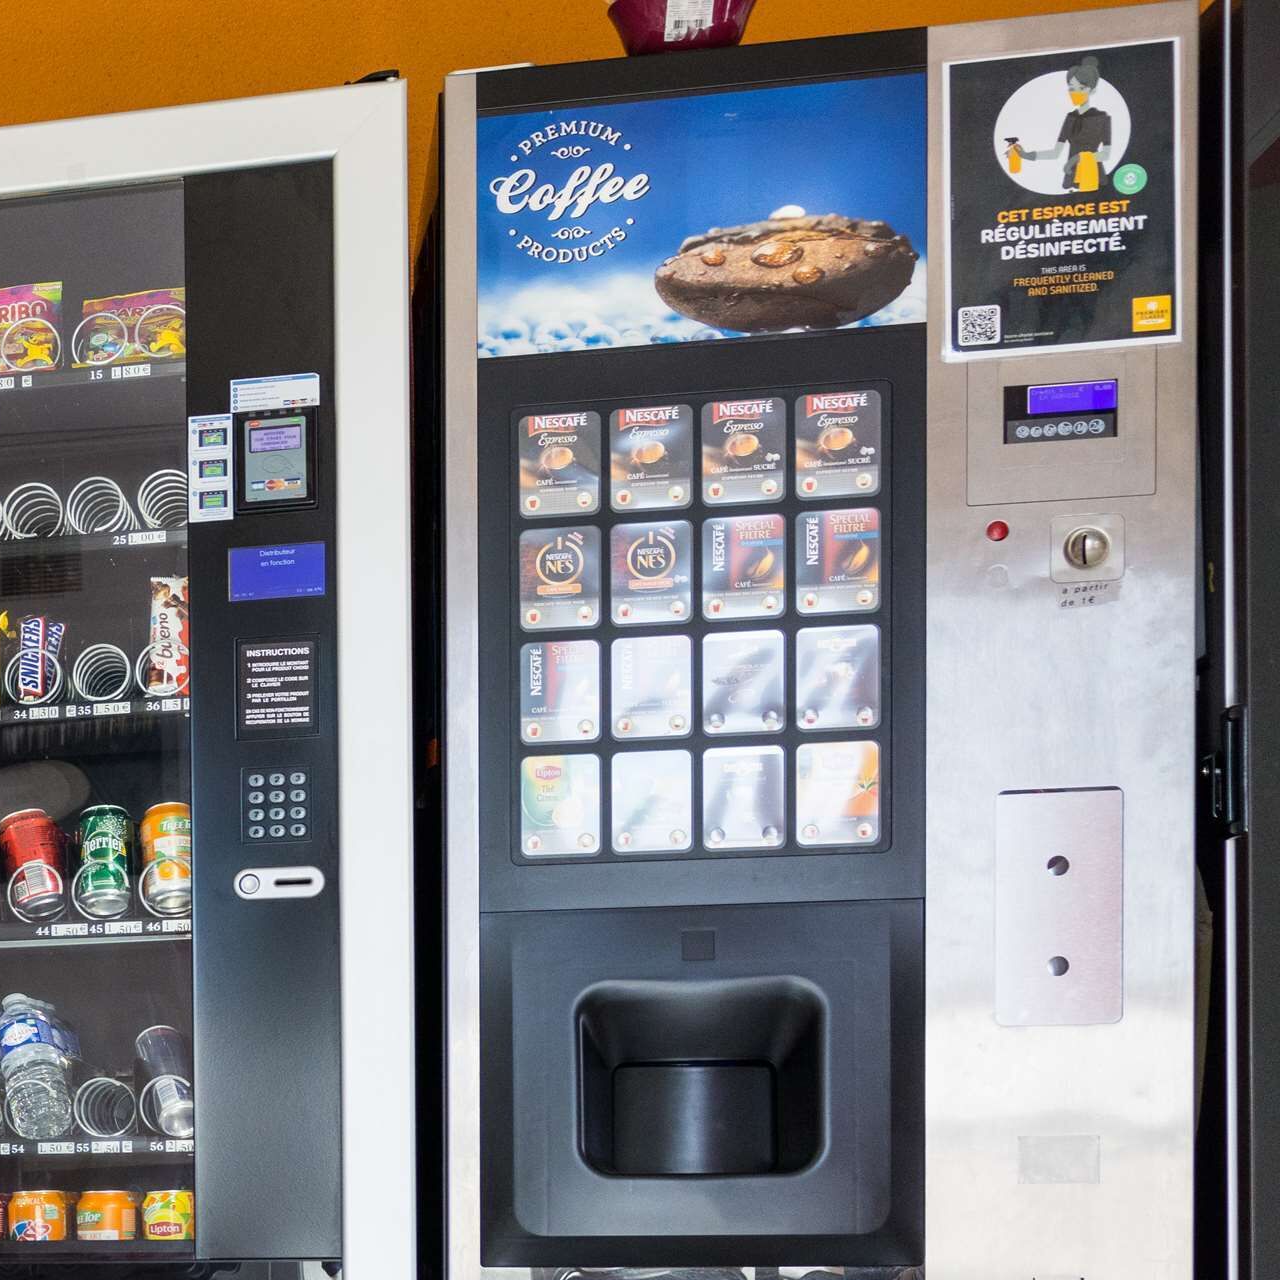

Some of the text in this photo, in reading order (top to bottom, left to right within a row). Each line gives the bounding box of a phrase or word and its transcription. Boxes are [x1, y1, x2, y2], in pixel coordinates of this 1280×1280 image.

[518, 120, 622, 155] PREMIUM
[490, 163, 651, 221] Coffee
[997, 200, 1130, 224] CET ESPACE EST
[980, 215, 1148, 244] RÉGULIÈREMENT
[516, 227, 627, 263] PRODUCTS
[1000, 233, 1126, 260] DÉSINFECTÉ.
[1041, 264, 1086, 274] THIS AREA IS
[1013, 271, 1115, 287] FREQUENTLY CLEANED
[1028, 287, 1048, 297] AND
[90, 370, 103, 380] 15
[719, 400, 773, 416] NESCAFÉ
[813, 393, 868, 410] NESCAFÉ
[534, 412, 587, 429] NESCAFÉ
[626, 406, 679, 422] NESCAFÉ
[817, 414, 858, 428] Espresso
[723, 420, 764, 434] Espresso
[538, 433, 578, 448] Espresso
[112, 535, 127, 545] 25
[713, 523, 725, 571] NESCAFÉ
[806, 515, 819, 565] NESCAFÉ
[1074, 583, 1109, 594] partir
[1061, 599, 1075, 607] de
[156, 612, 173, 659] bueno
[246, 647, 310, 657] INSTRUCTIONS
[530, 647, 542, 696] NESCAFÉ
[77, 706, 91, 715] 35
[146, 702, 160, 711] 36
[14, 710, 28, 719] 34
[35, 926, 51, 936] 44
[89, 924, 104, 934] 45
[146, 922, 161, 931] 46
[11, 1145, 25, 1153] 54
[76, 1143, 90, 1152] 55
[150, 1142, 164, 1151] 56
[151, 1224, 180, 1234] Lipton
